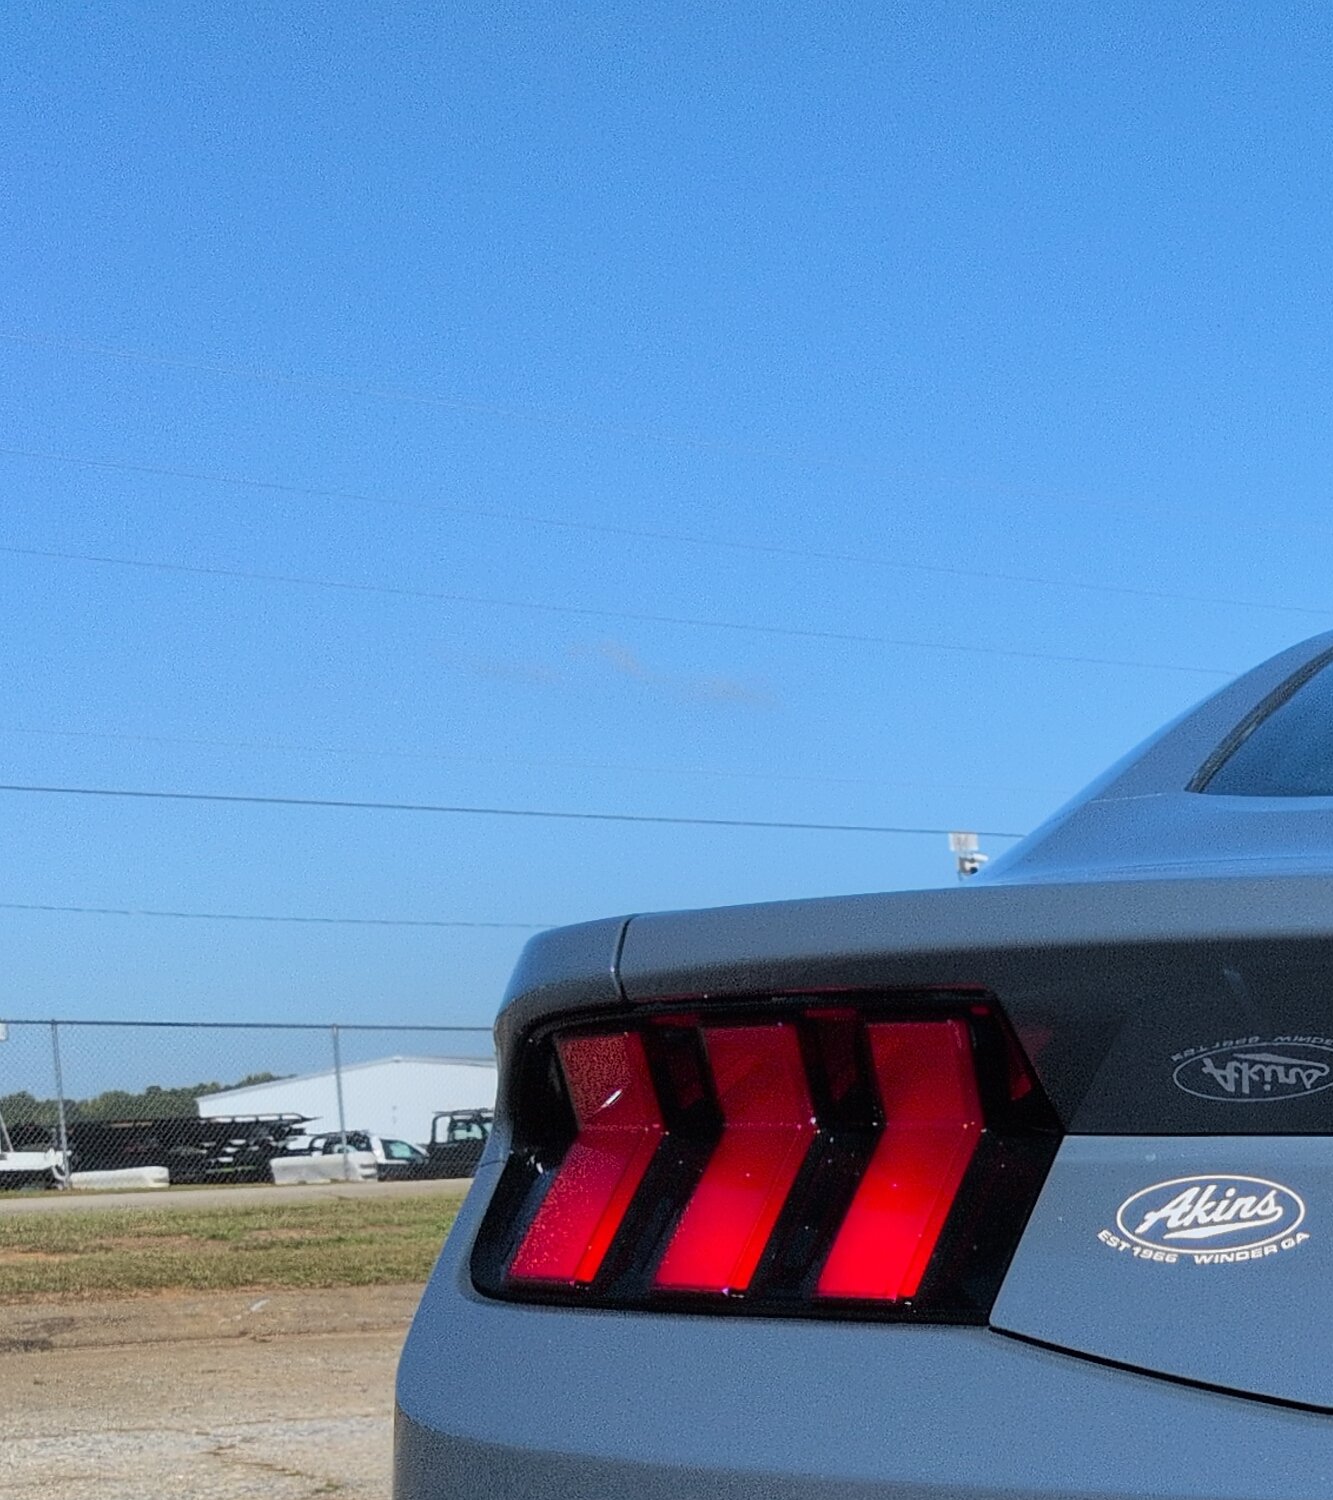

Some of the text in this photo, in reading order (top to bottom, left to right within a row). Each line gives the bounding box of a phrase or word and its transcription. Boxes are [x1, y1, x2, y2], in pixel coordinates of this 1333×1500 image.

[1134, 1184, 1283, 1239] Akins
[1096, 1229, 1310, 1264] EST 1966 WINDER GA
